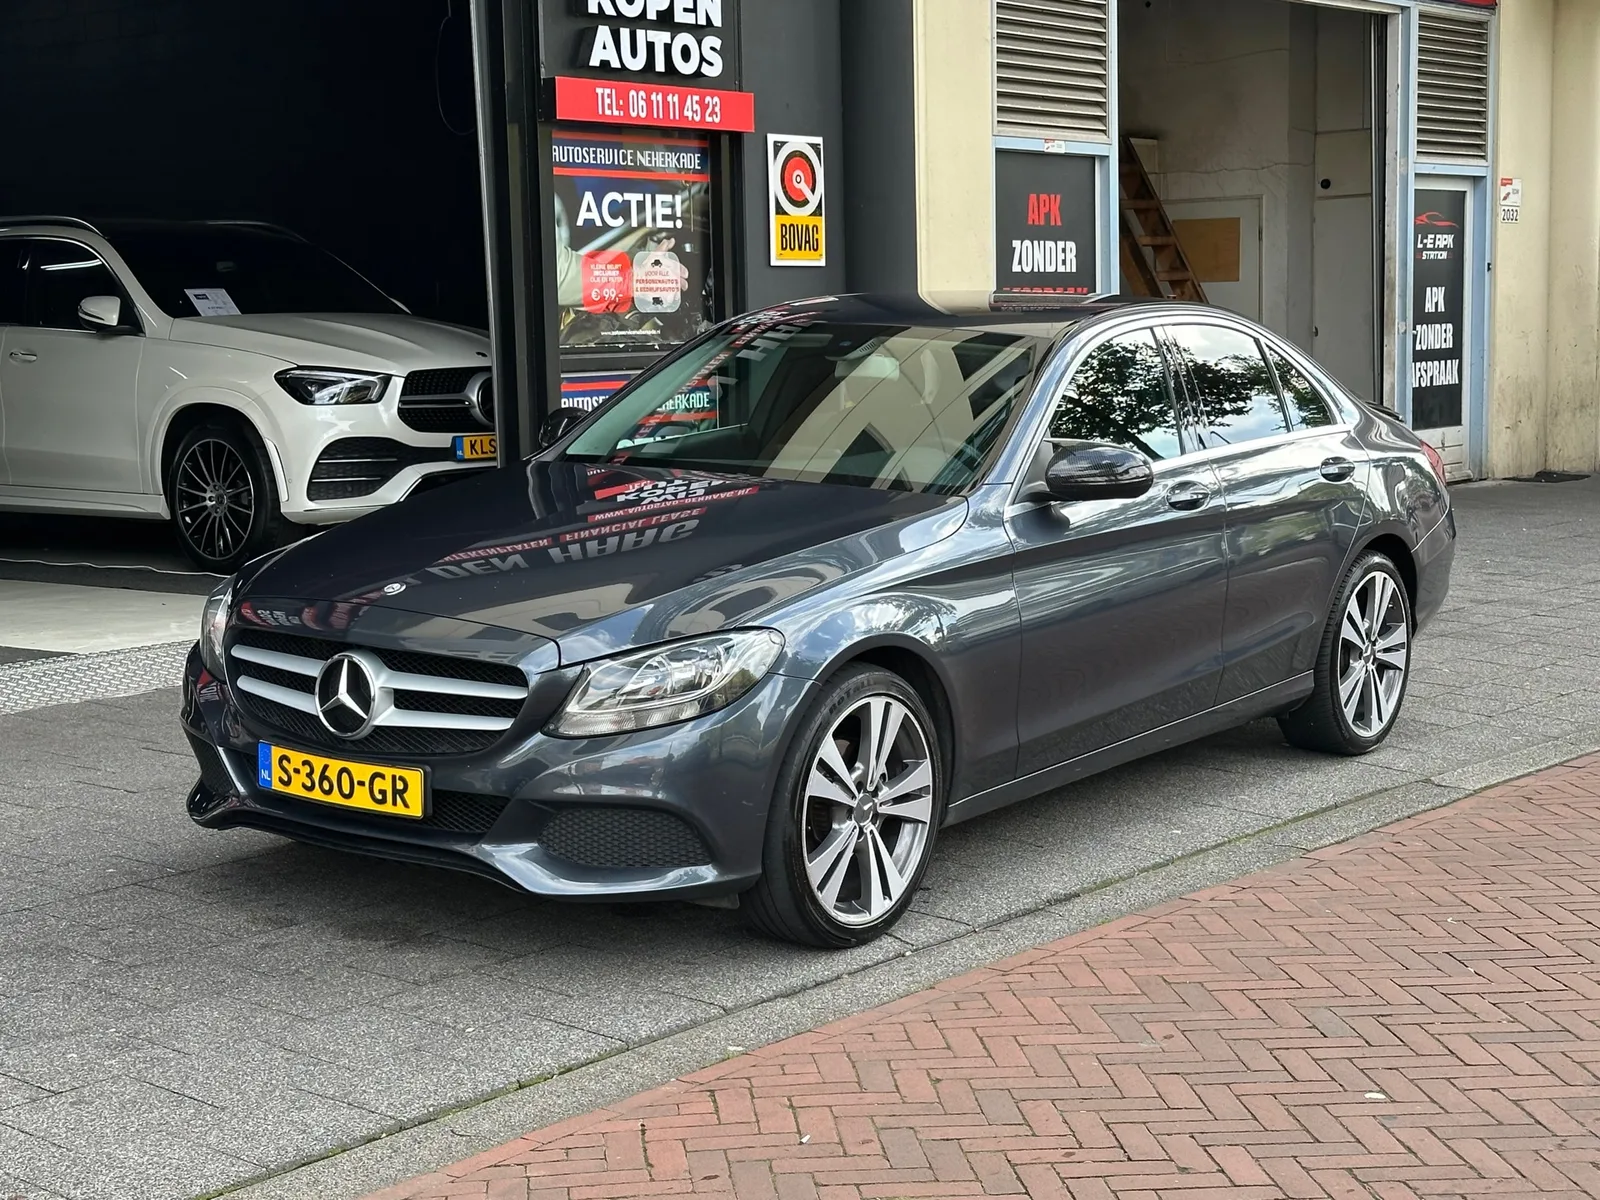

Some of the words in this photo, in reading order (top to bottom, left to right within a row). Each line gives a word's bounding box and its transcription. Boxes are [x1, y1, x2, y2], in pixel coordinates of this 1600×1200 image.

[589, 25, 723, 77] AUTOS
[595, 87, 624, 116] TEL:
[628, 89, 647, 118] 06
[650, 91, 663, 119] 11
[667, 93, 679, 120] 11
[683, 94, 701, 122] 45
[704, 95, 721, 123] 23
[552, 145, 634, 166] AUTOSERVICE
[636, 150, 701, 169] NEHERKADE
[576, 191, 683, 229] ACTIE!
[1027, 194, 1062, 226] APK
[1502, 208, 1519, 221] 2032
[781, 223, 819, 252] BOVAG
[1417, 234, 1434, 248] L-E
[1435, 234, 1454, 249] APK
[1011, 239, 1077, 273] ZONDER
[1421, 250, 1448, 260] STATION
[591, 288, 600, 301] €
[1425, 287, 1445, 313] APK
[1415, 323, 1453, 351] ZONDER
[469, 438, 497, 456] KLS
[261, 769, 271, 781] NL
[278, 754, 410, 809] S-360-GR
